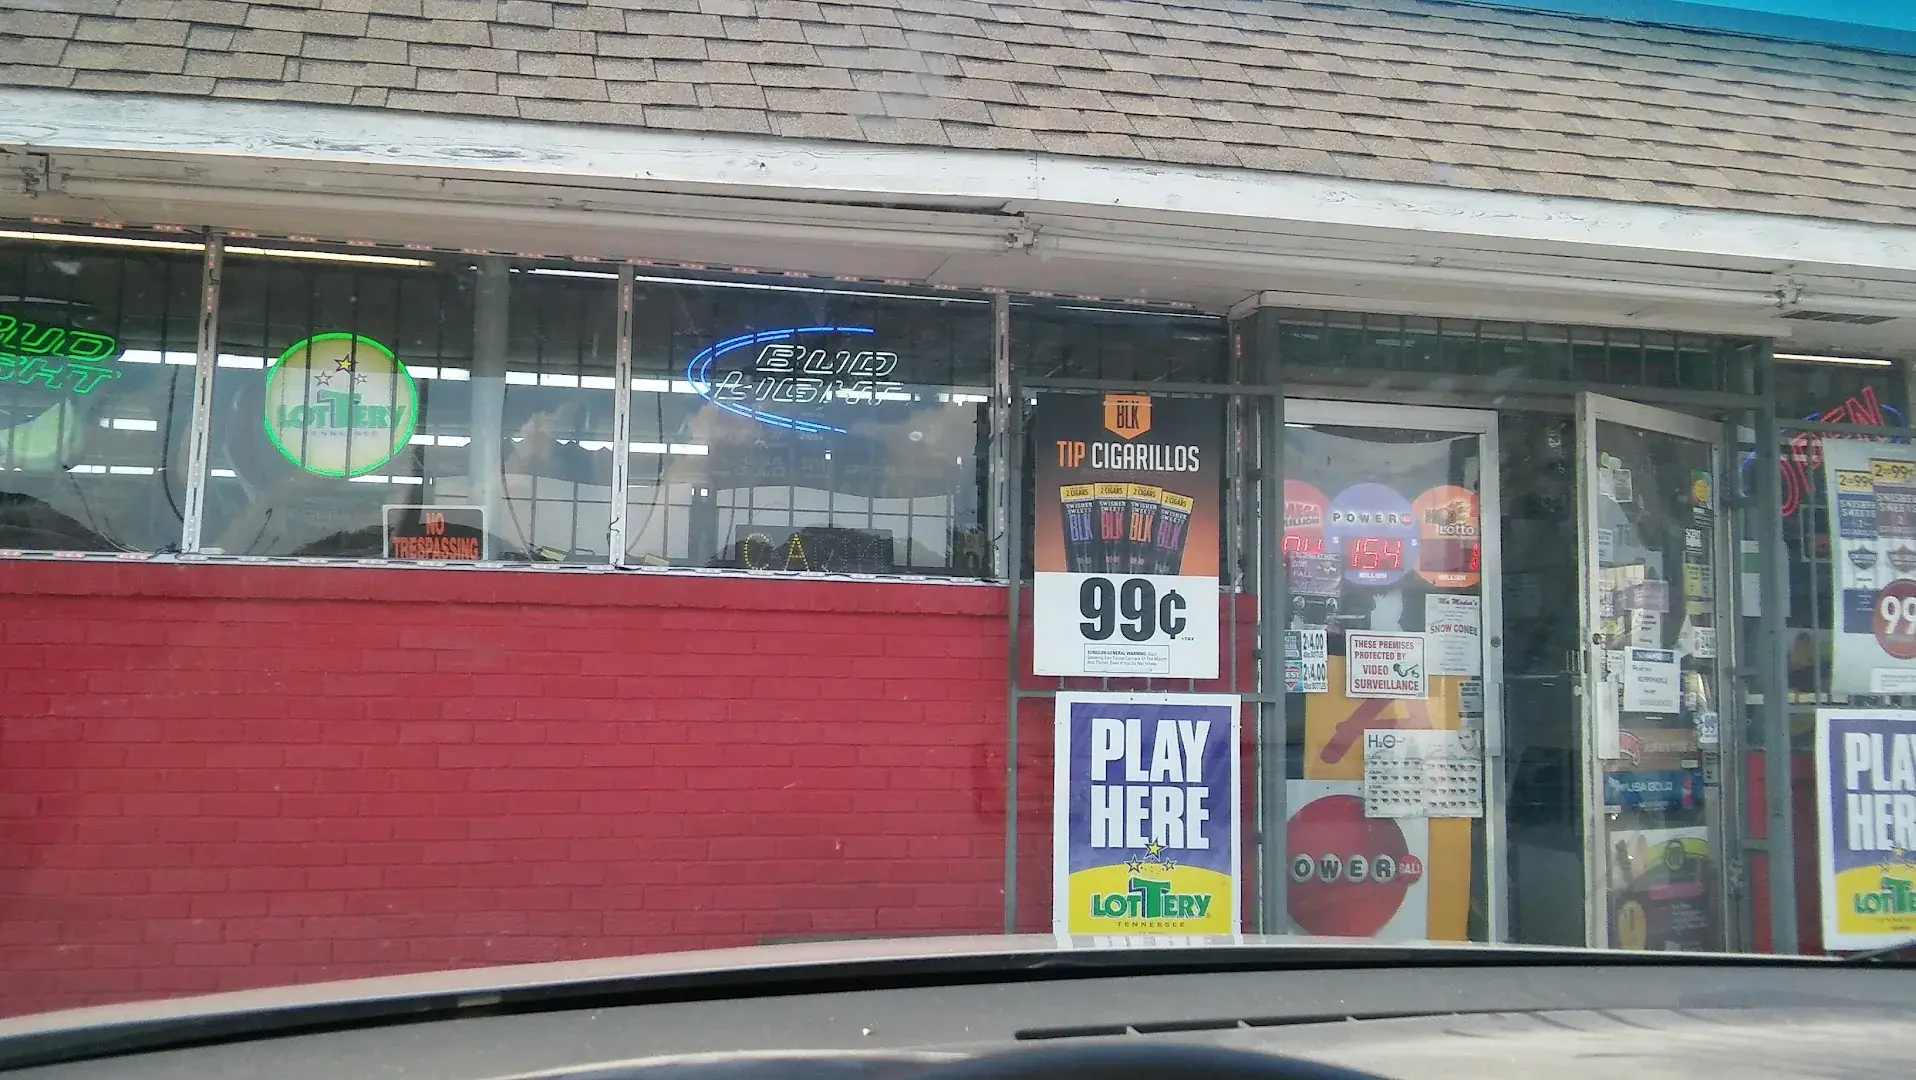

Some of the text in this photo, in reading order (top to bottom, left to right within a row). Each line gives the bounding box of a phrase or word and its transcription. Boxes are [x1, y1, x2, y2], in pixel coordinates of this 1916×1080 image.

[756, 344, 898, 377] BUD
[277, 389, 408, 429] LOTTERY
[1116, 400, 1140, 430] BLK
[1056, 440, 1201, 473] TIP CIGARILLOS
[1071, 487, 1089, 497] CIGARS
[1104, 486, 1124, 495] CIGARS
[1137, 488, 1157, 498] CIGARS
[1168, 498, 1187, 507] CIGARS
[426, 512, 445, 535] NO
[1069, 512, 1094, 542] BLK
[1101, 511, 1124, 541] BLK
[1129, 512, 1154, 543] BLK
[1333, 511, 1397, 525] POWER
[392, 536, 480, 560] TRESPASSING
[1157, 521, 1183, 550] BLK
[1079, 576, 1187, 642] 99¢
[1430, 624, 1478, 636] SNOW CONES
[1354, 639, 1414, 650] THESE PREMISES
[1354, 651, 1406, 661] PROTECTED BY
[1362, 664, 1389, 676] VIDEO
[1354, 679, 1420, 692] SURVEILLANCE
[1090, 717, 1211, 783] PLAY
[1845, 732, 1916, 790] PLA
[1090, 784, 1211, 850] HERE
[1090, 877, 1212, 919] LOTTERY
[1117, 920, 1186, 928] TENNESSEE
